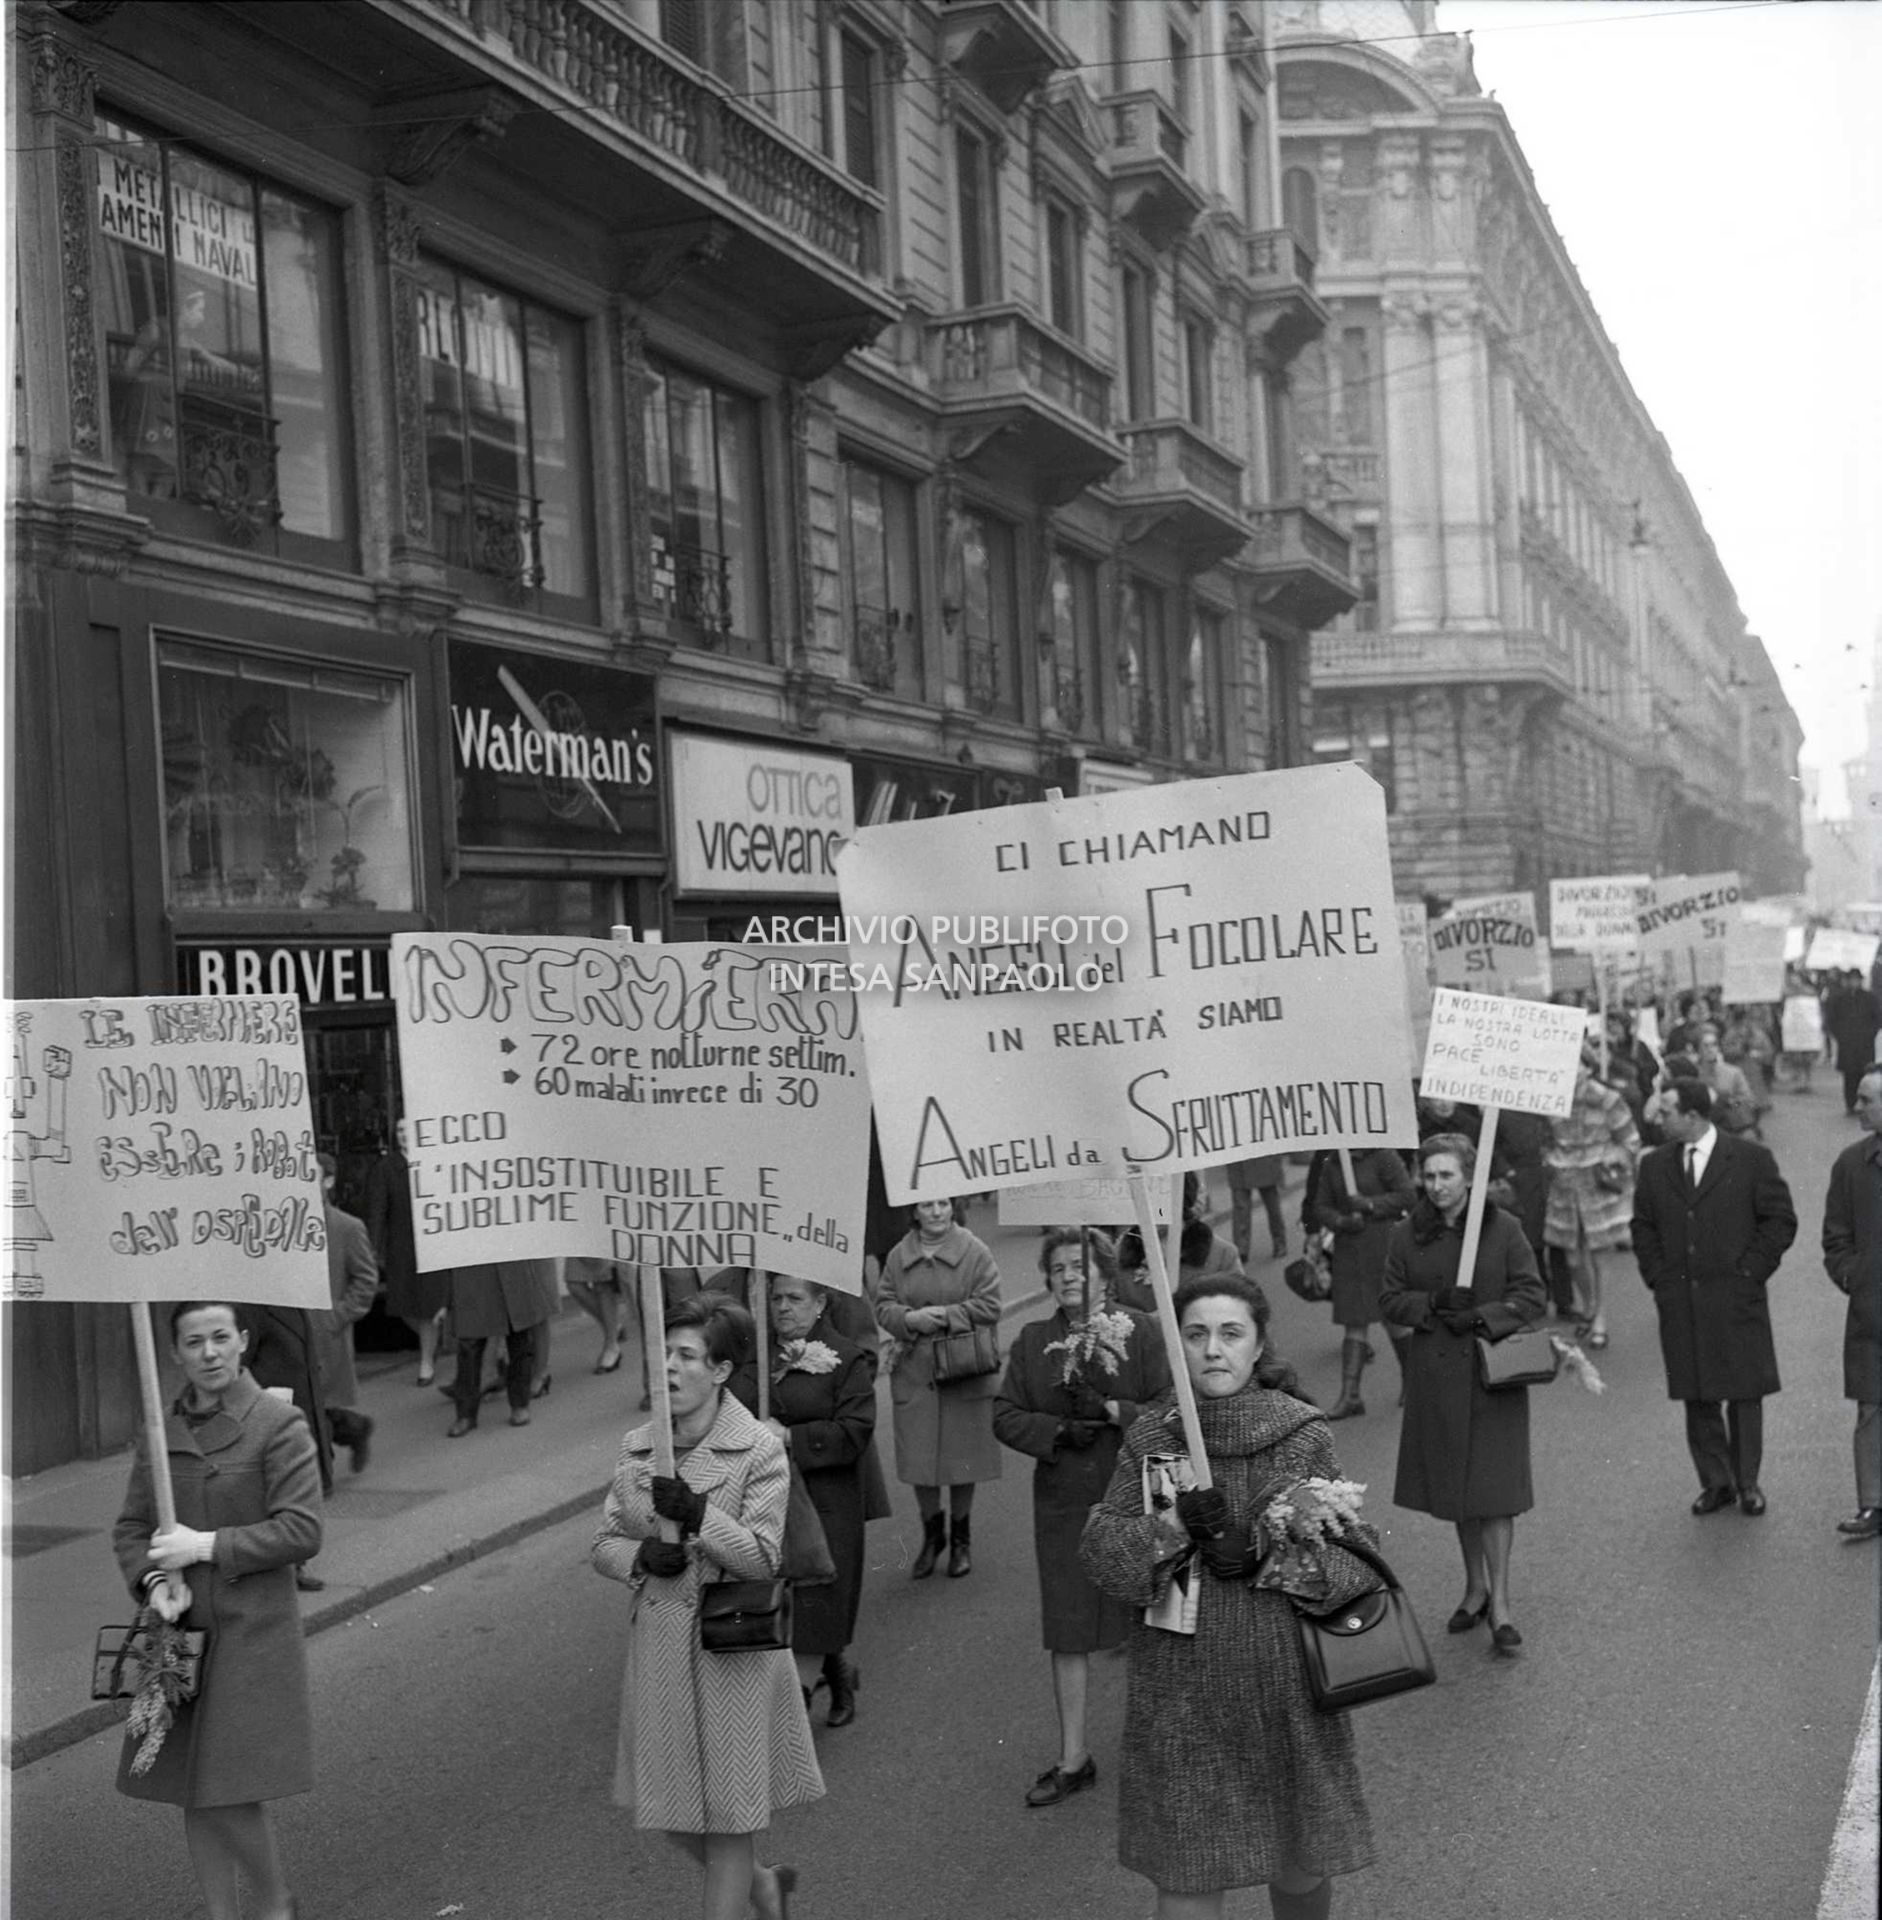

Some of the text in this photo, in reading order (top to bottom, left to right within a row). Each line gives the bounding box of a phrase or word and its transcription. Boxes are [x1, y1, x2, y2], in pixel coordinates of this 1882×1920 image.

[451, 704, 653, 786] Waterman's
[996, 810, 1271, 872] CI CHIAMANO
[1637, 887, 1739, 934] DIVORZIO
[1702, 918, 1726, 938] SI
[1434, 918, 1534, 950] DIVORZIO
[1466, 948, 1496, 971] SI
[79, 1009, 134, 1049] LE
[987, 1028, 1024, 1052] IN
[1197, 996, 1283, 1030] SIAMO
[1438, 1013, 1579, 1042] LA NOSTRA LOTTA
[1512, 1007, 1564, 1025] IDEALI
[530, 1031, 856, 1078] 72 ore notturne settim.
[1433, 1043, 1483, 1063] PACE
[1472, 1034, 1520, 1051] SONO
[99, 1063, 177, 1120] NON
[534, 1066, 819, 1108] 60 malati invece di 30
[1427, 1078, 1565, 1112] INDIPENDENZA
[414, 1111, 506, 1148] ECCO
[1067, 1139, 1103, 1167] da
[1121, 1069, 1389, 1163] SFRUTTAMENTO
[759, 1167, 780, 1199] E
[422, 1192, 579, 1235] SUBLIME
[797, 1212, 848, 1254] della
[611, 1228, 756, 1267] DONNA
